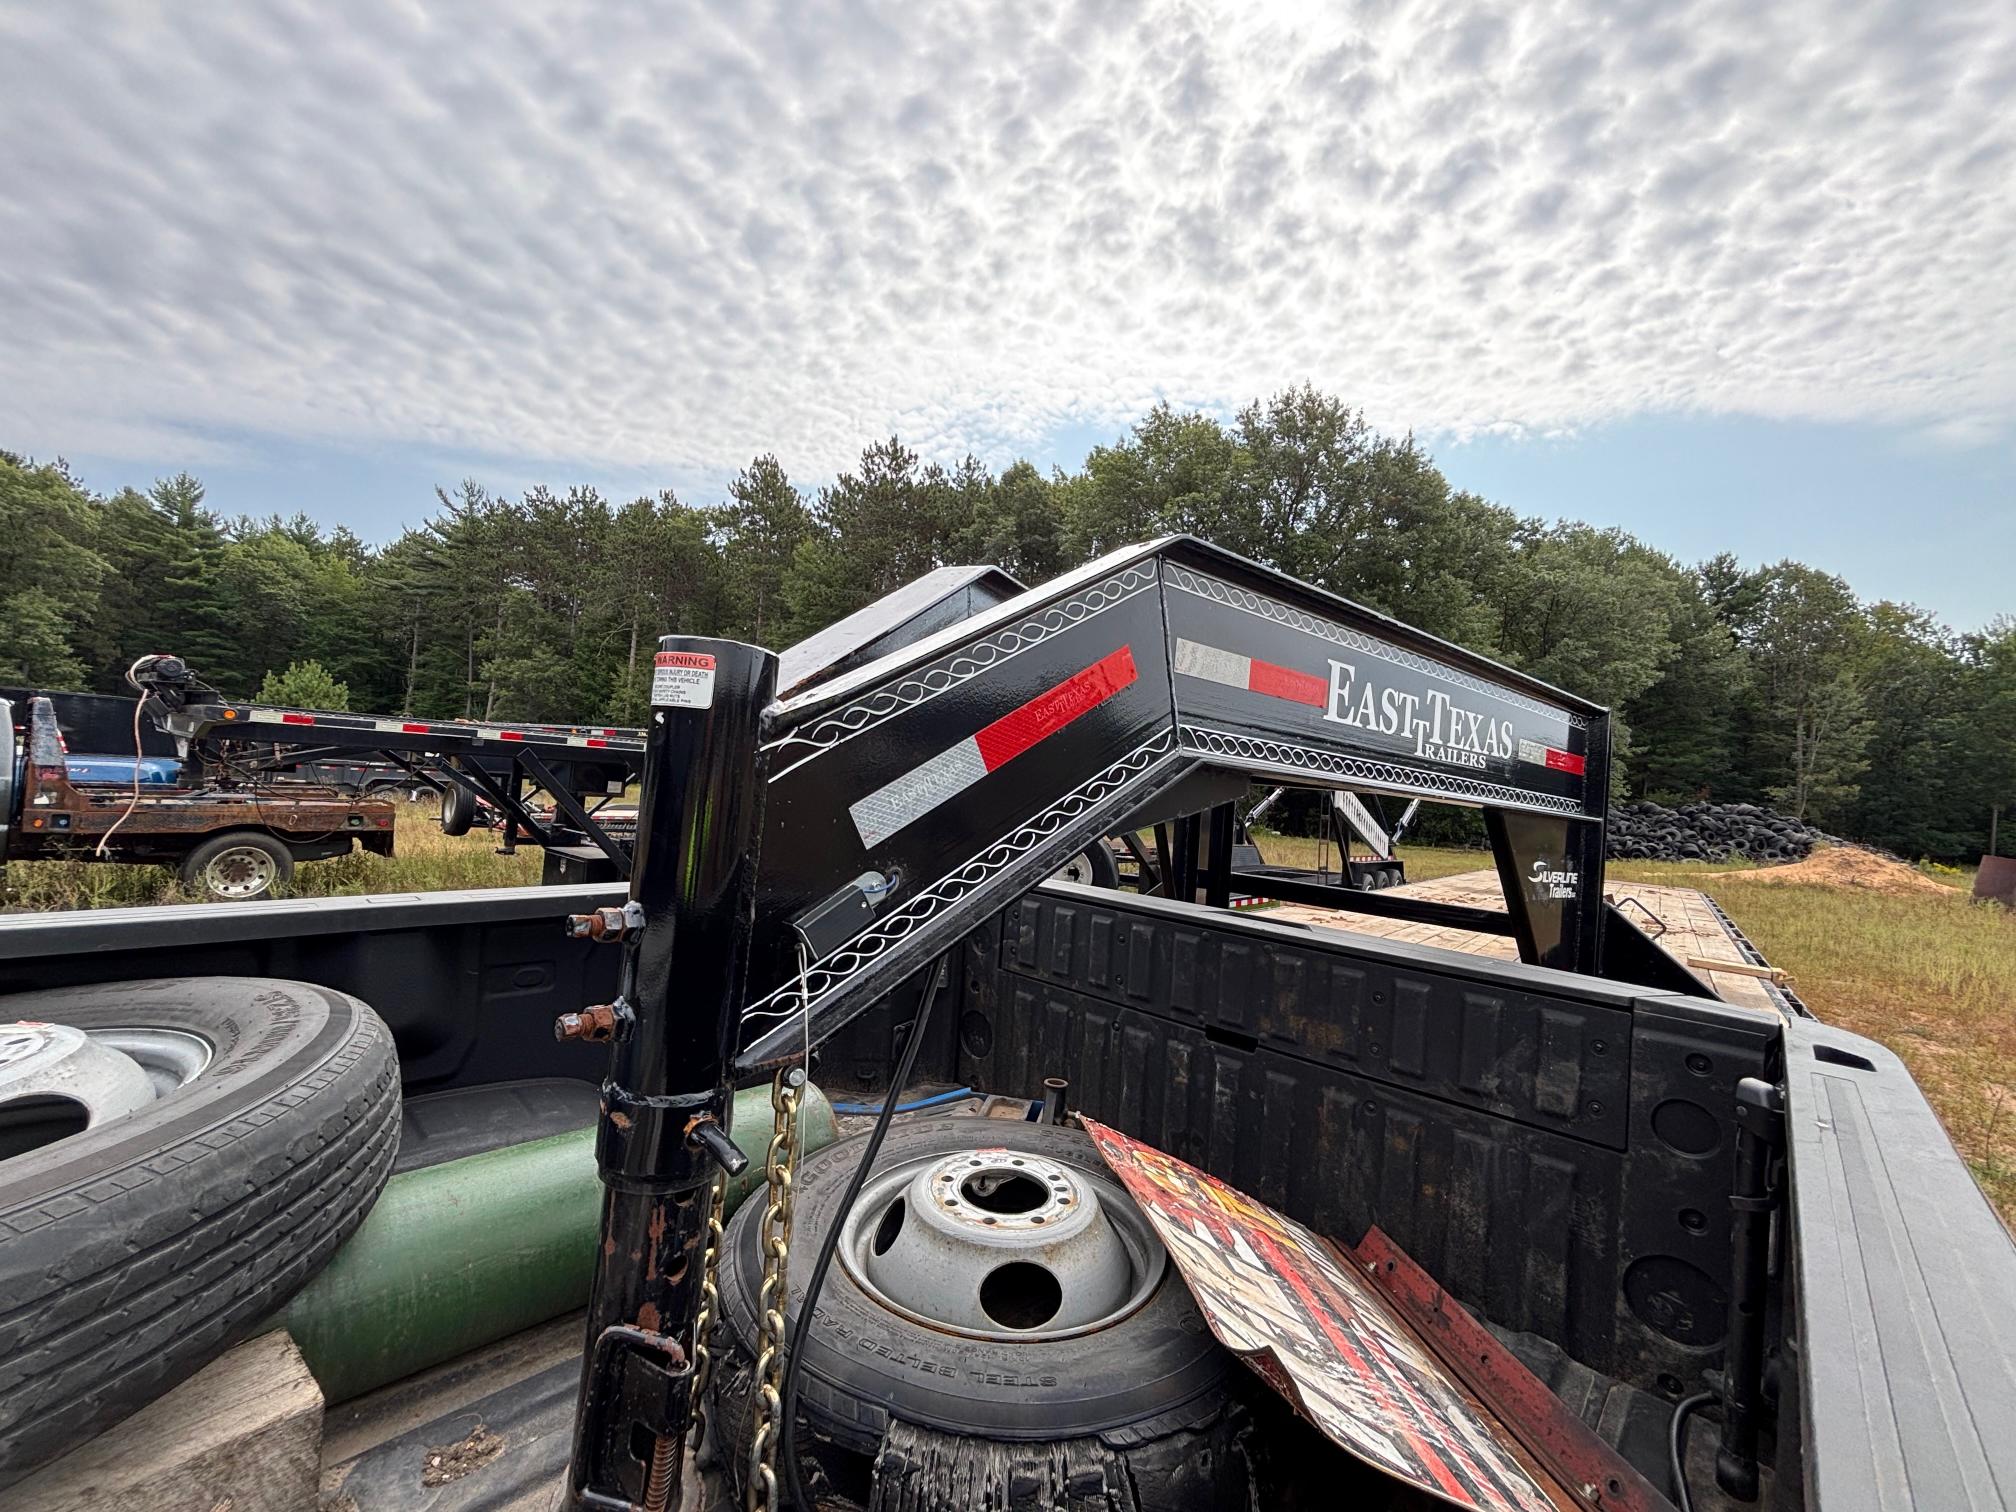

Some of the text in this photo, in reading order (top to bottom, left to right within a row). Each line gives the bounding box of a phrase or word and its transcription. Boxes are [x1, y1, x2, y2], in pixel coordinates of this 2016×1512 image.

[657, 655, 709, 667] WARNING
[1323, 658, 1513, 760] EAST TEXAS
[1412, 719, 1487, 769] TRAILERS
[790, 1284, 855, 1339] RADAL
[858, 1337, 960, 1379] BELTED
[970, 1370, 1059, 1388] STEEL
